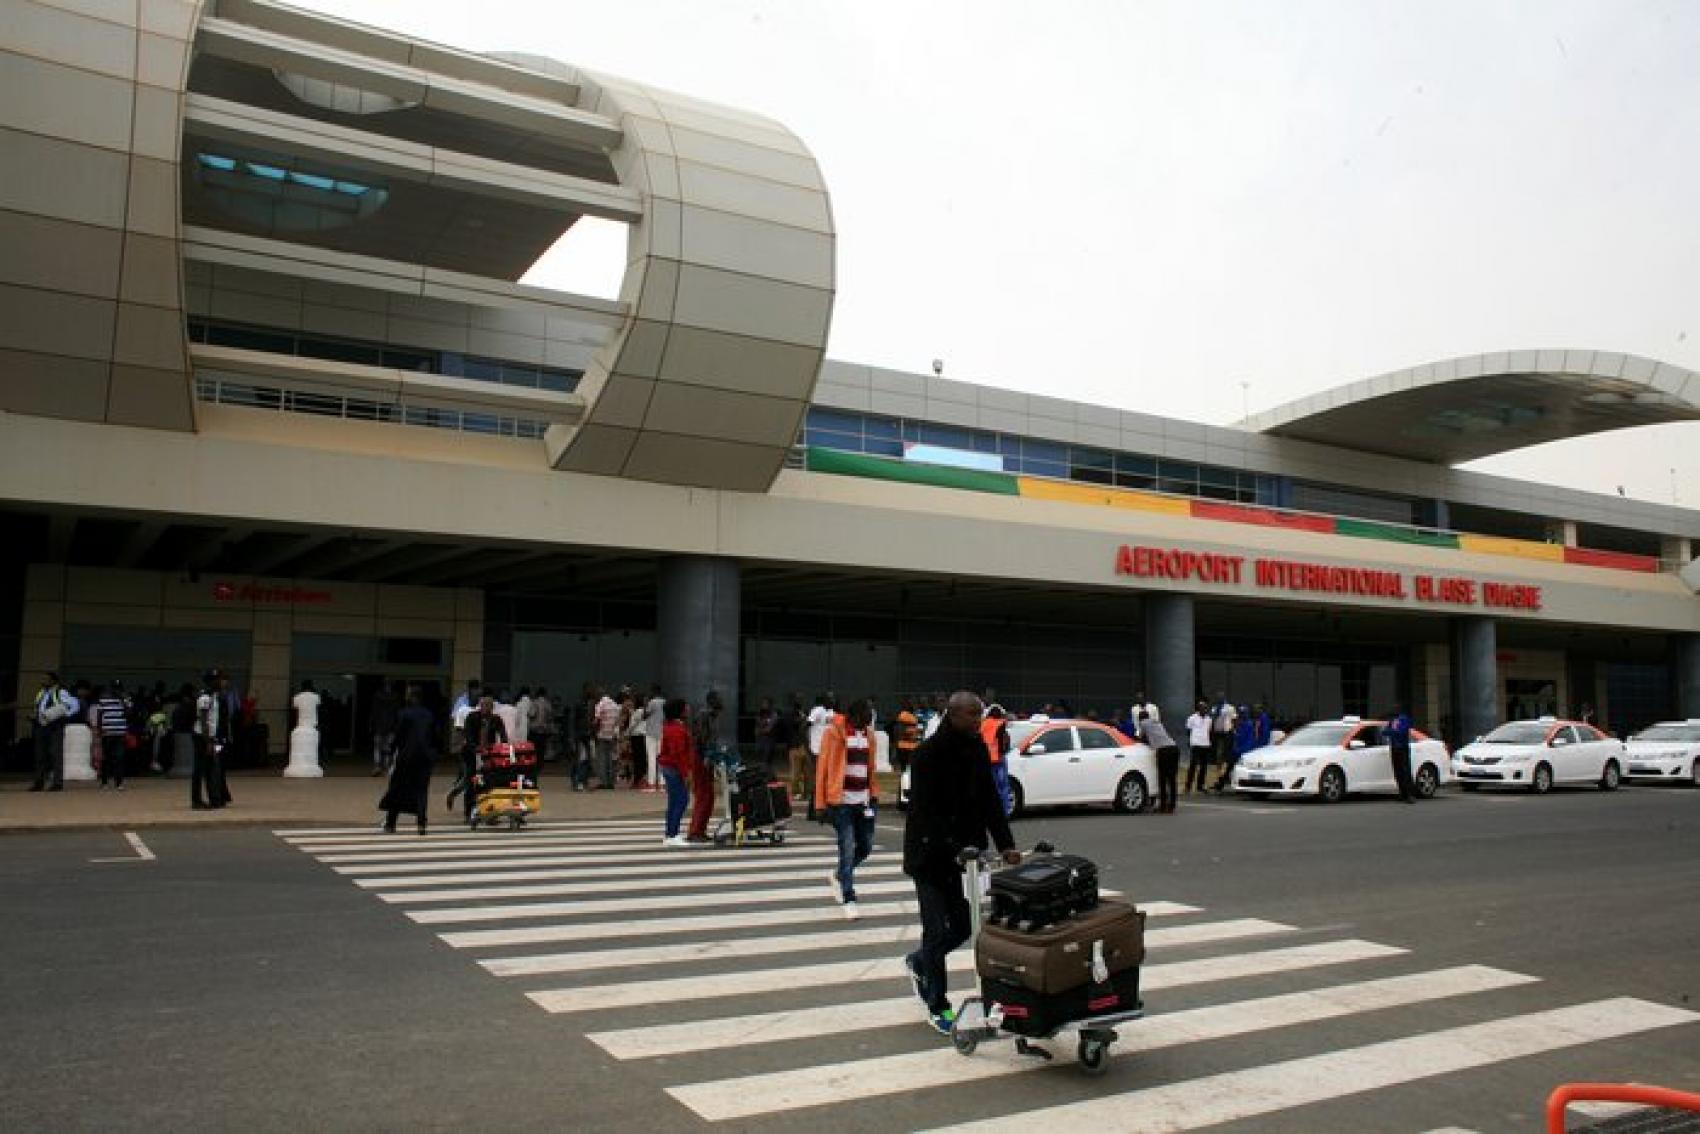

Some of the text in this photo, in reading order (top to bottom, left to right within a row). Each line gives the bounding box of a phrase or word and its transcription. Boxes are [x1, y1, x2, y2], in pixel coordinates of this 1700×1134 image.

[1115, 544, 1245, 584] AEROPORT
[1254, 557, 1407, 599] INTERNATIONAL
[1413, 574, 1477, 605] BLAISE
